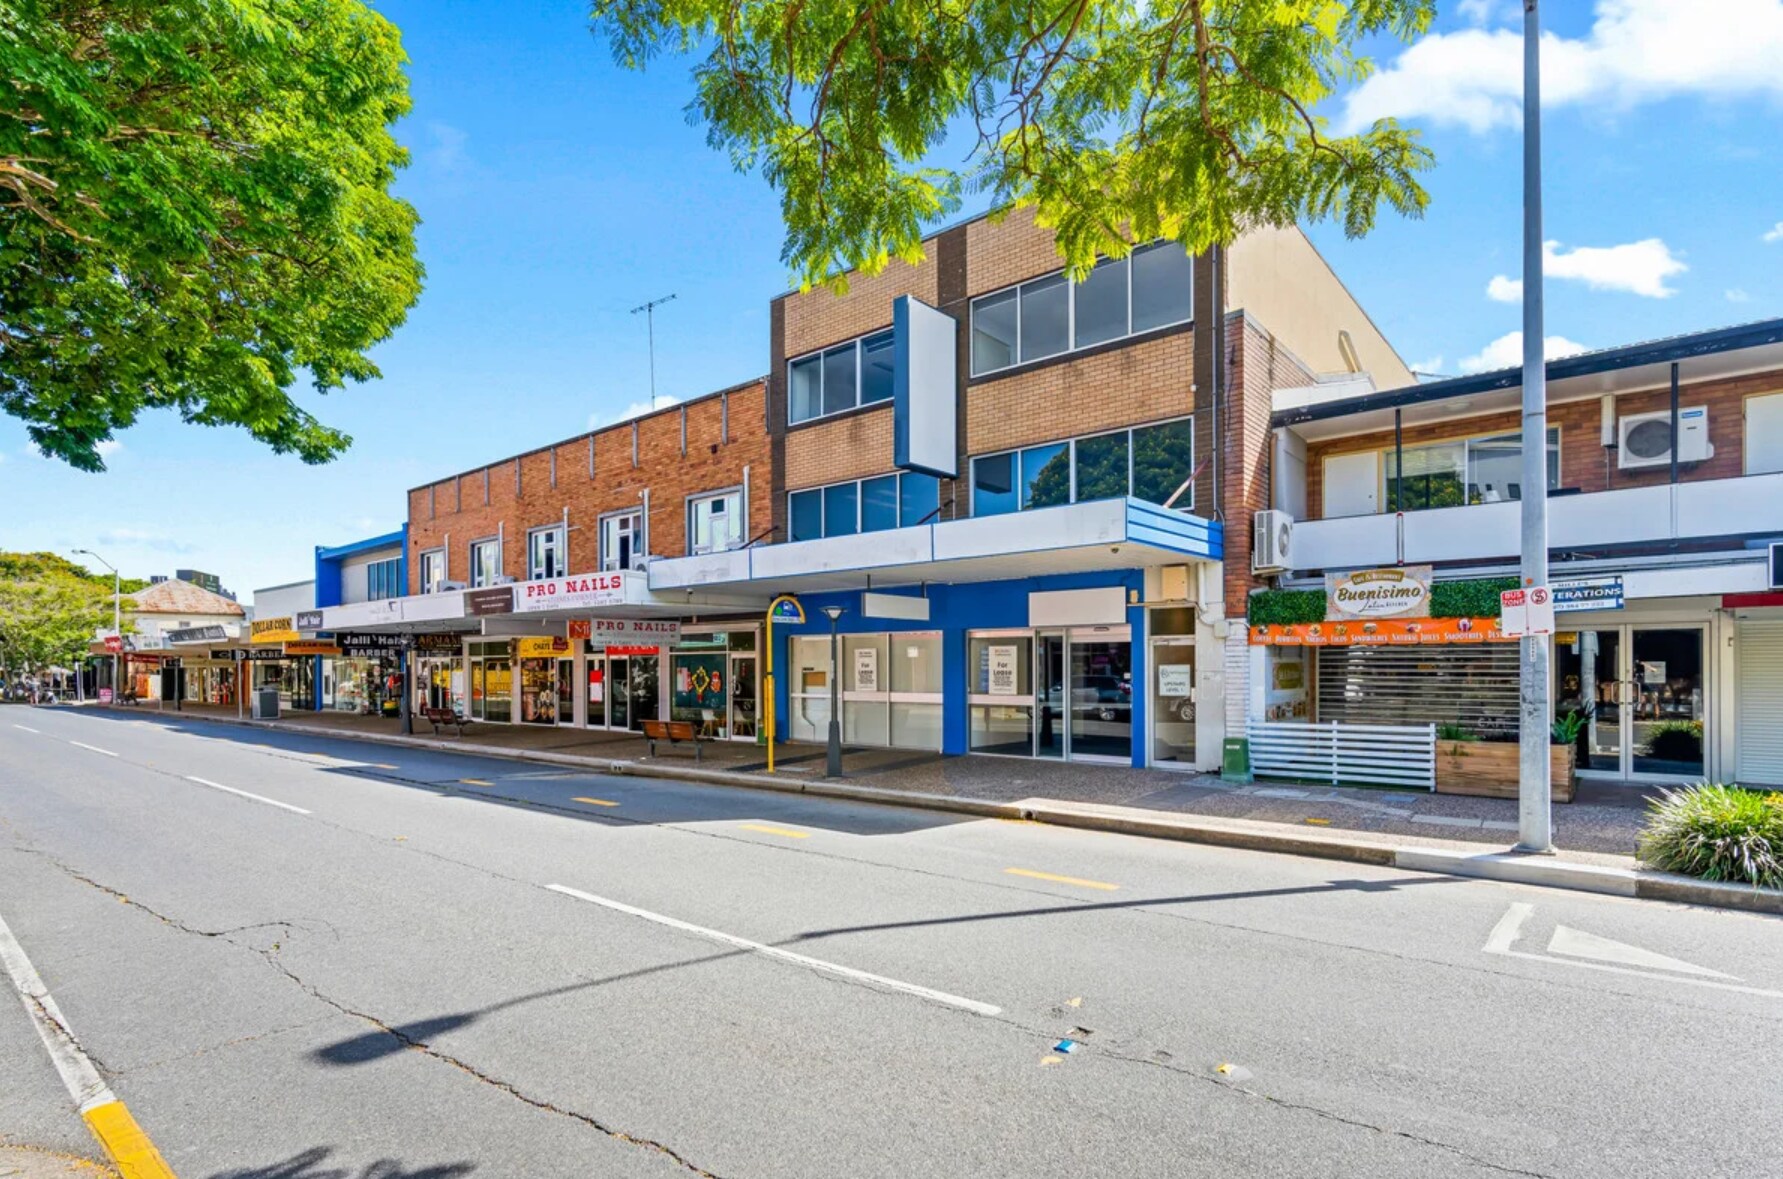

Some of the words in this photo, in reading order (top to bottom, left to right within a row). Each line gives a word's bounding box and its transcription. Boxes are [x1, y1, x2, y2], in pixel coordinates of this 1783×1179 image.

[527, 583, 557, 597] PRO
[566, 576, 621, 593] NAILS
[1337, 585, 1421, 601] Buenisimo
[1504, 591, 1522, 599] BUS
[1503, 599, 1524, 607] ZONE
[597, 621, 625, 631] PRO
[634, 622, 677, 632] NAILS
[350, 649, 396, 657] BARBER
